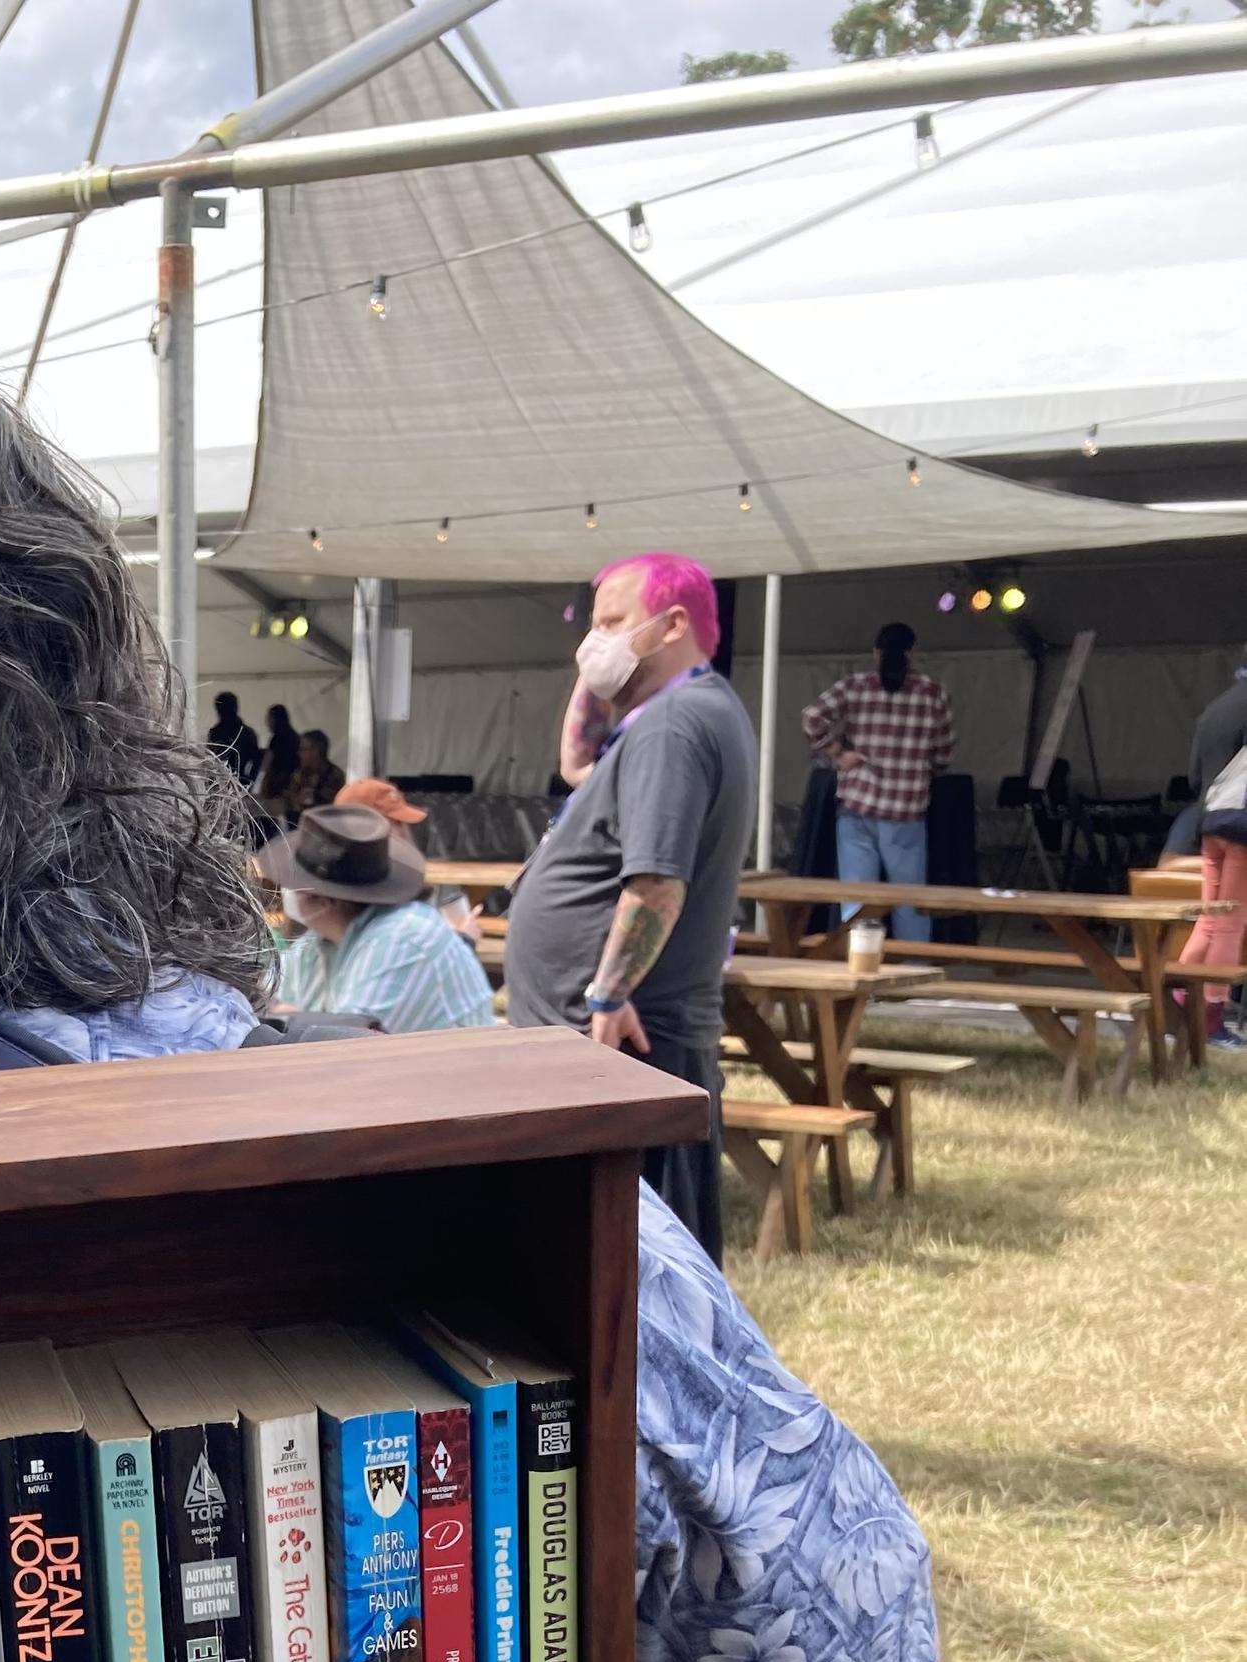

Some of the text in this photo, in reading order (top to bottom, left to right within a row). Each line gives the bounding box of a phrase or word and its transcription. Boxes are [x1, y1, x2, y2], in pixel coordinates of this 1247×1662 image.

[541, 1411, 568, 1421] BOOKS
[541, 1425, 570, 1439] DEL
[363, 1435, 409, 1452] TOR
[542, 1438, 570, 1452] REY
[280, 1451, 299, 1461] JOVE
[366, 1450, 409, 1465] fantasy
[273, 1463, 308, 1475] MYSTERY
[23, 1472, 53, 1483] BERKLEY
[110, 1480, 144, 1490] ARCHWAY
[27, 1485, 50, 1494] NOVEL
[107, 1488, 149, 1500] PAPERBACK
[267, 1480, 315, 1496] New York
[422, 1485, 458, 1495] HARLEQUIN
[112, 1500, 145, 1510] YA NOVEL
[277, 1495, 305, 1509] Times
[186, 1506, 224, 1523] TOR
[267, 1508, 317, 1524] Bestseller
[191, 1525, 221, 1536] science
[195, 1536, 219, 1545] fiction
[373, 1531, 404, 1552] PIERS
[542, 1482, 567, 1604] DOUGLAS
[361, 1550, 417, 1576] ANTHONY
[494, 1526, 513, 1613] Freddie
[186, 1565, 232, 1585] AUTHOR'S
[432, 1574, 448, 1583] JAN
[45, 1536, 85, 1637] DEAN
[184, 1581, 236, 1600] DEFINITIVE
[432, 1584, 459, 1595] 2568
[284, 1574, 312, 1624] The
[368, 1590, 408, 1613] FAUN
[192, 1599, 230, 1616] EDITION
[383, 1612, 394, 1631] &
[363, 1629, 418, 1655] GAMES
